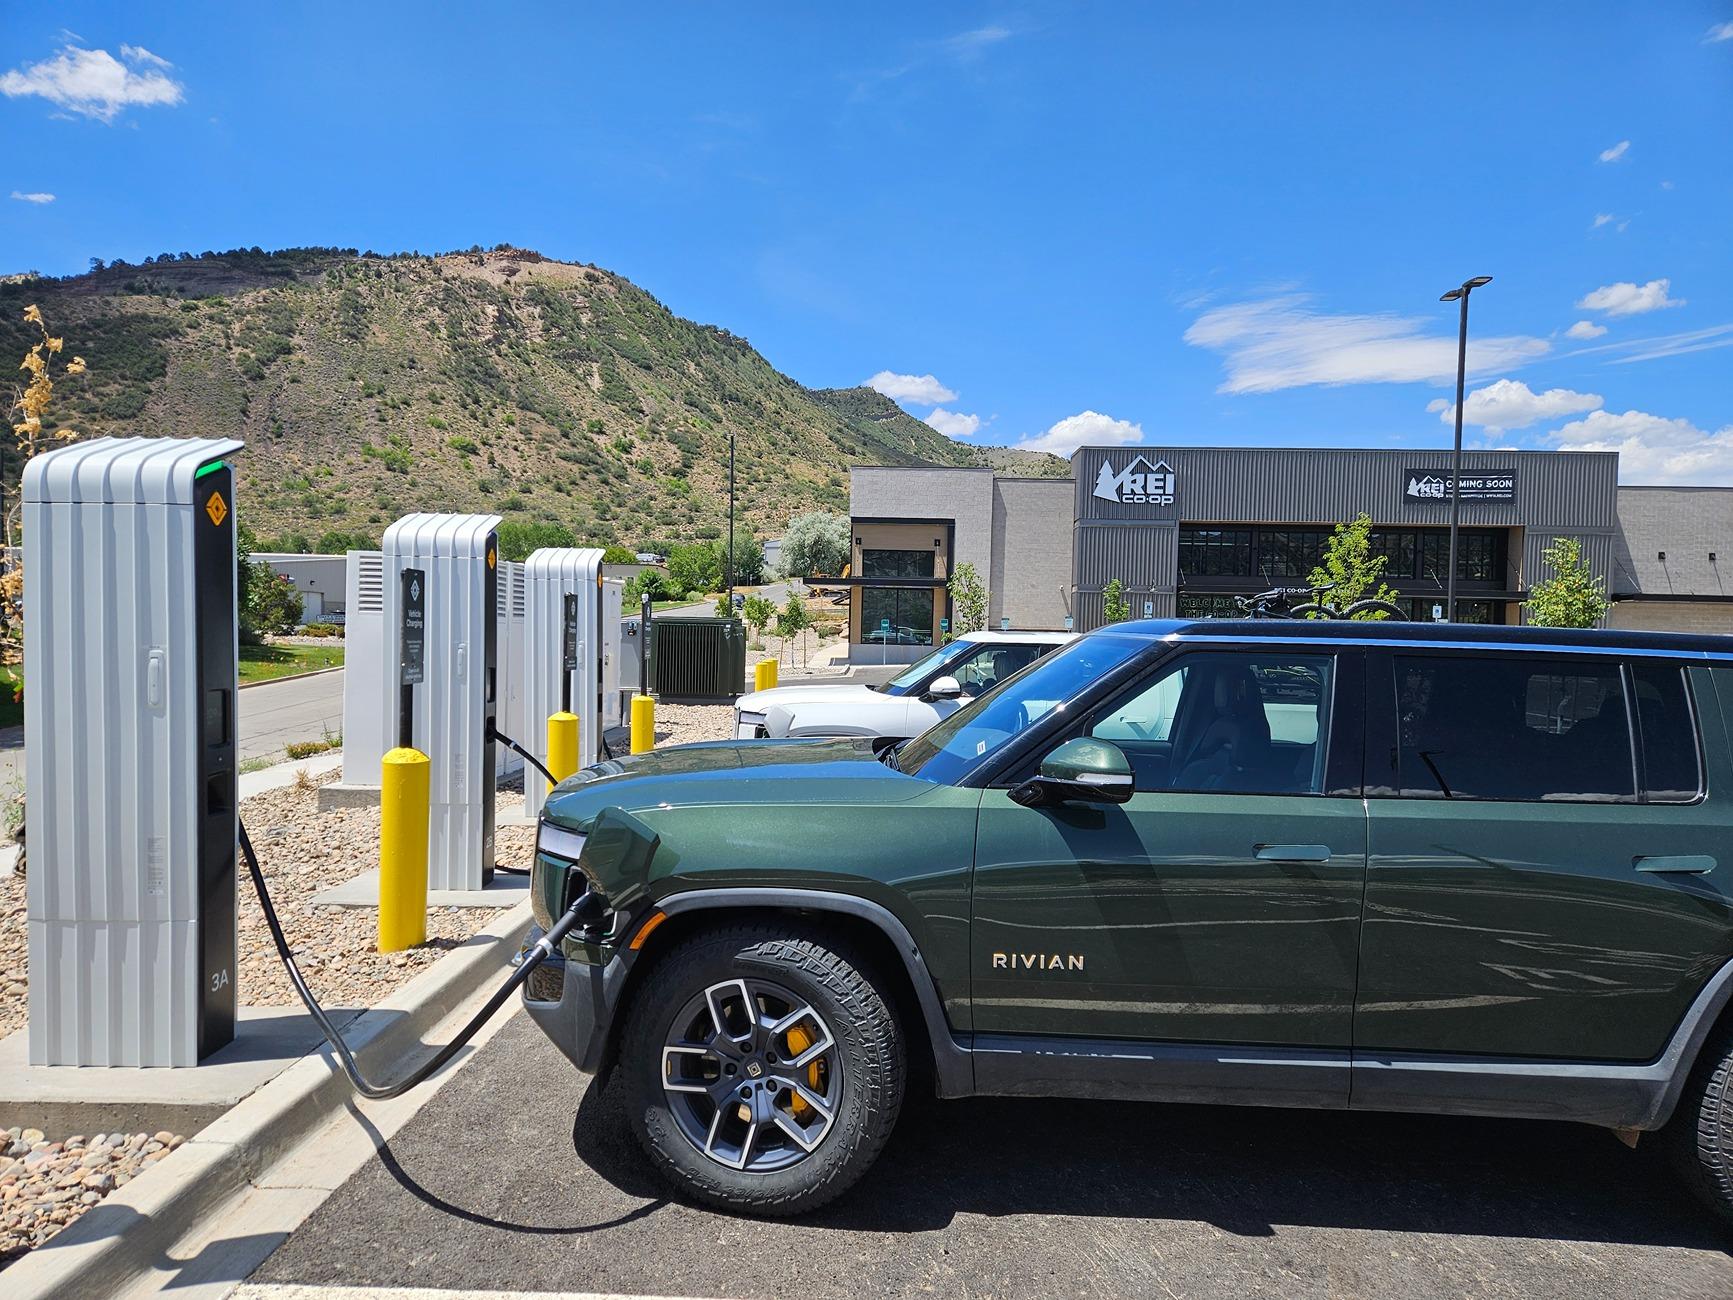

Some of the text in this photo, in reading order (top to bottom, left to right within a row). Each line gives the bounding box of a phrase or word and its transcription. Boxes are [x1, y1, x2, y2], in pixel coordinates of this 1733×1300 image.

[1122, 473, 1175, 494] REI
[1419, 483, 1445, 493] REI
[1445, 480, 1513, 488] CMING SOON
[992, 953, 1085, 971] RIVIAN
[211, 968, 229, 992] 3A
